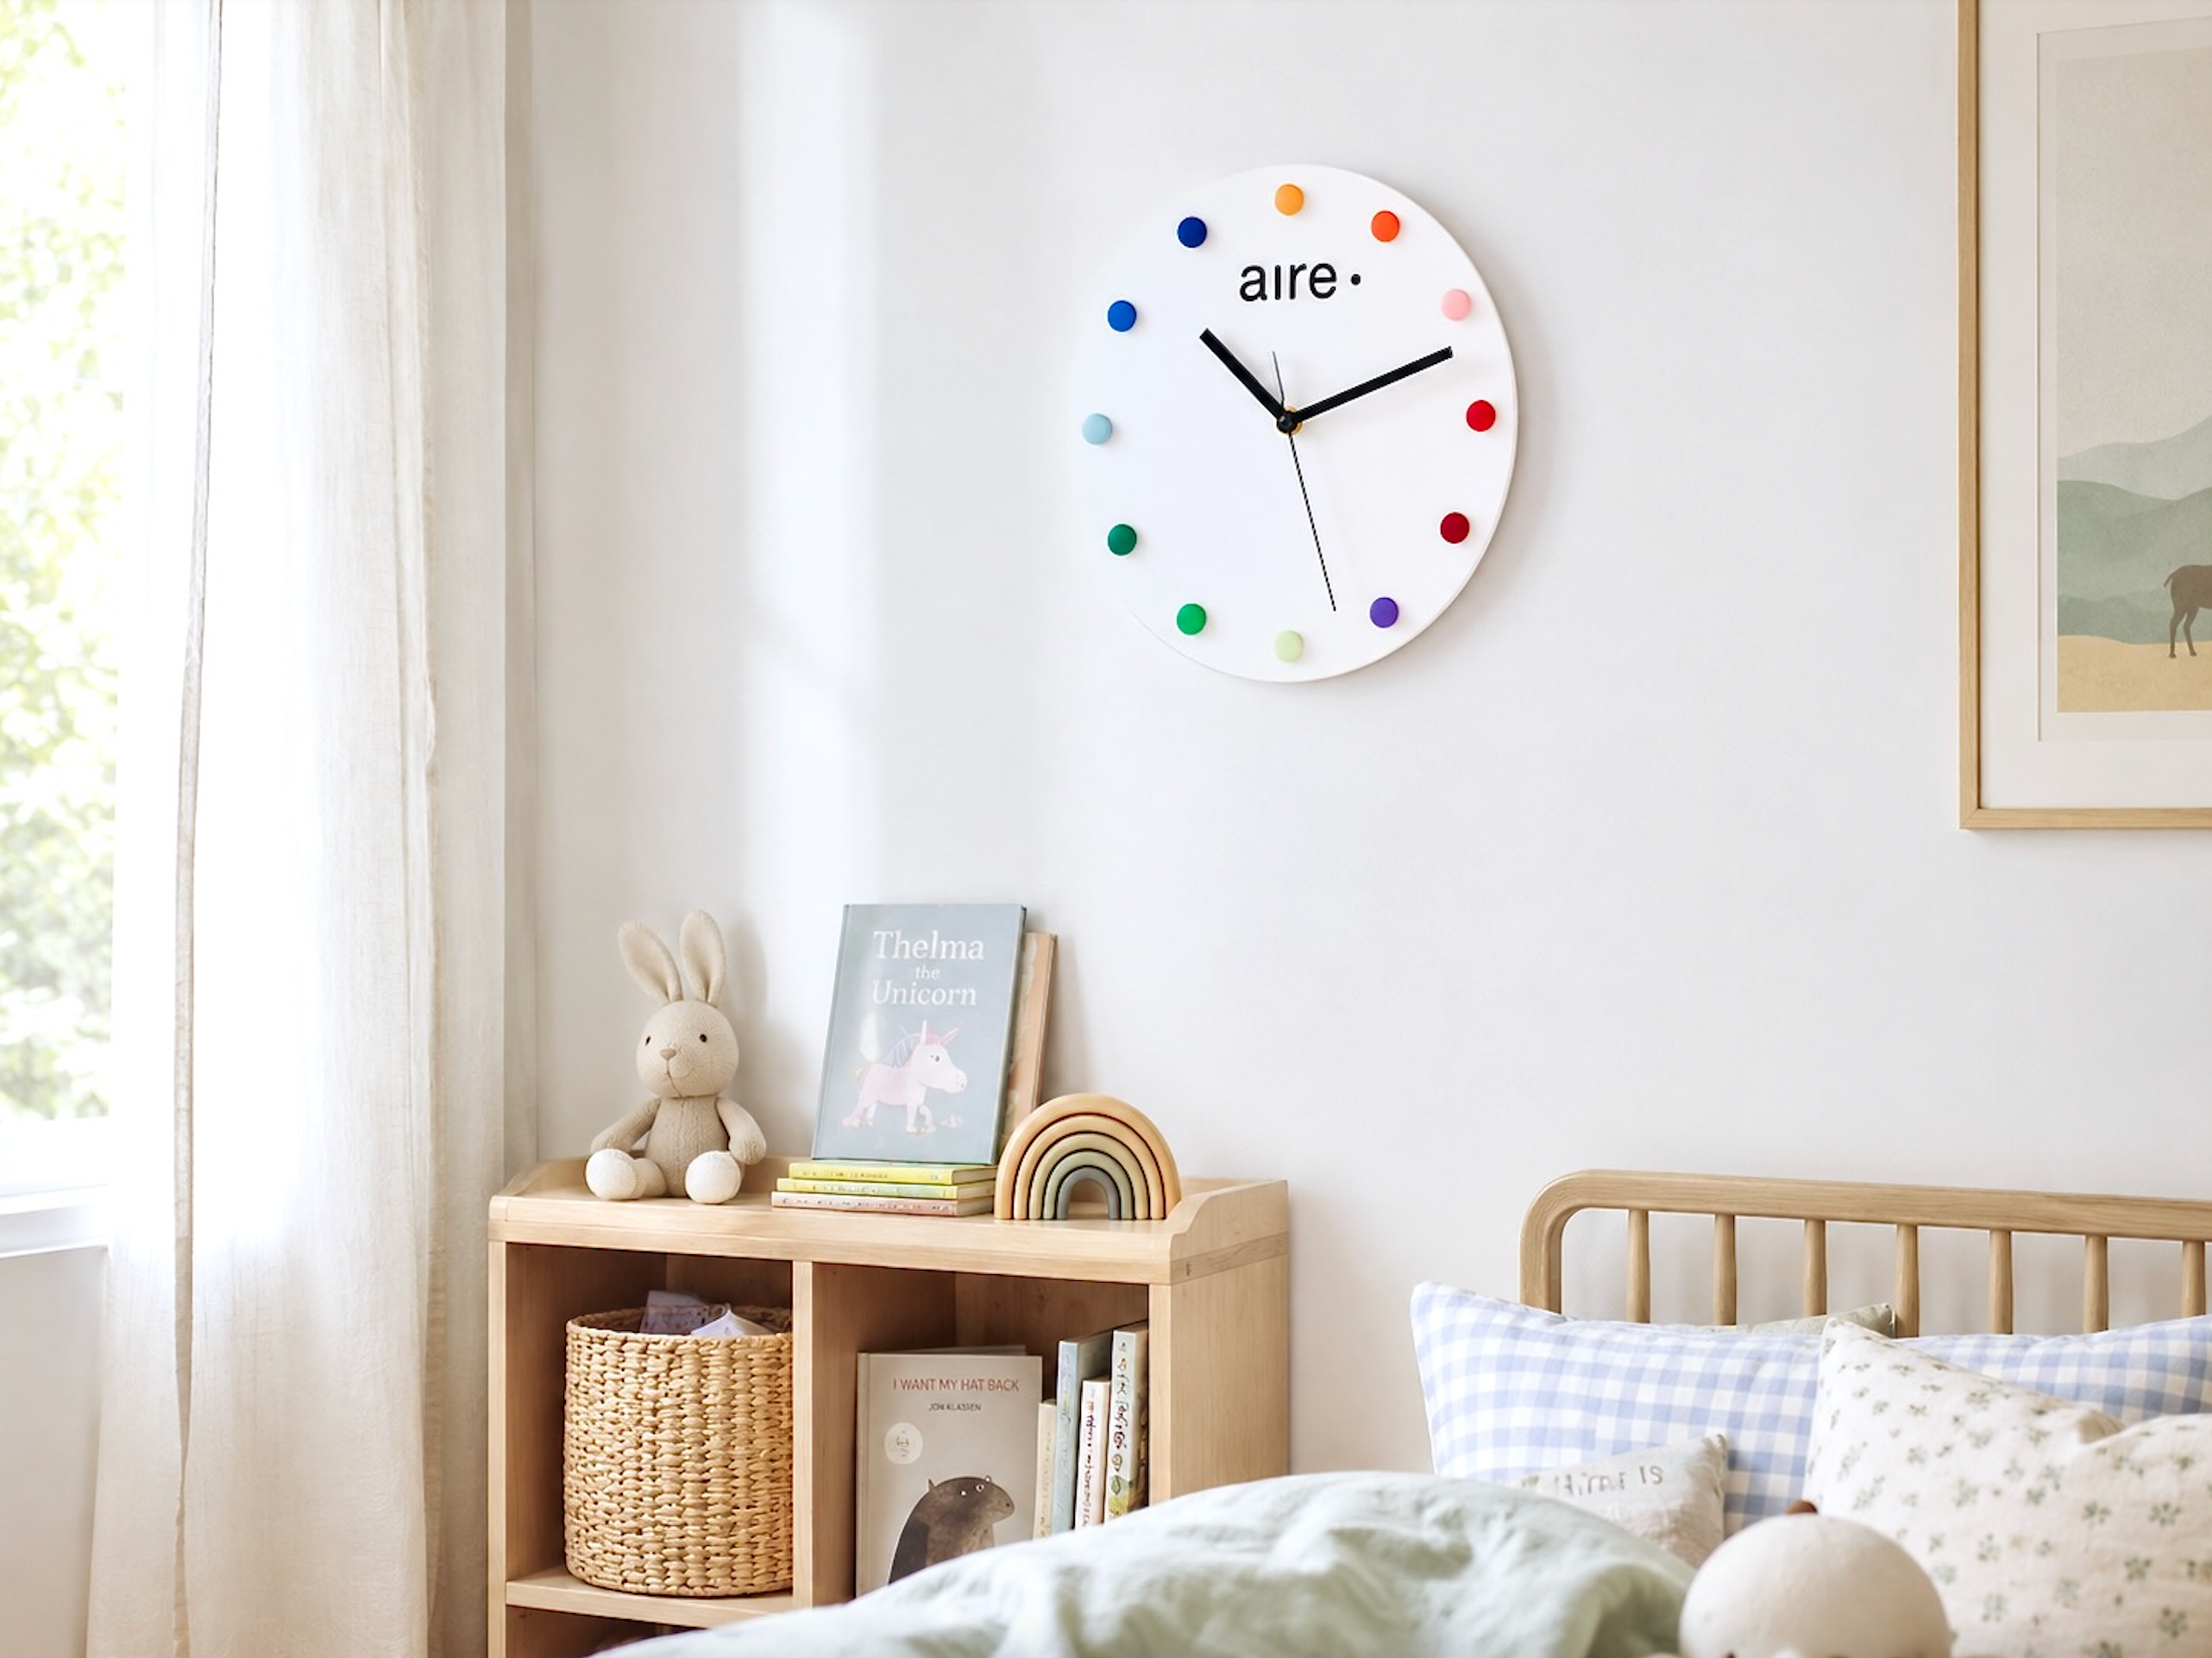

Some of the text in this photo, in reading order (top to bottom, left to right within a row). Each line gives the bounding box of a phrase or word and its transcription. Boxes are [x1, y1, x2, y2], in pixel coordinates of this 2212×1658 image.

[873, 930, 984, 960] Thelma
[915, 965, 940, 980] the
[871, 980, 977, 1006] Unicorn
[900, 1379, 936, 1391] WANT
[939, 1379, 958, 1391] MY
[960, 1379, 983, 1391] HAT
[988, 1379, 1020, 1391] BACK
